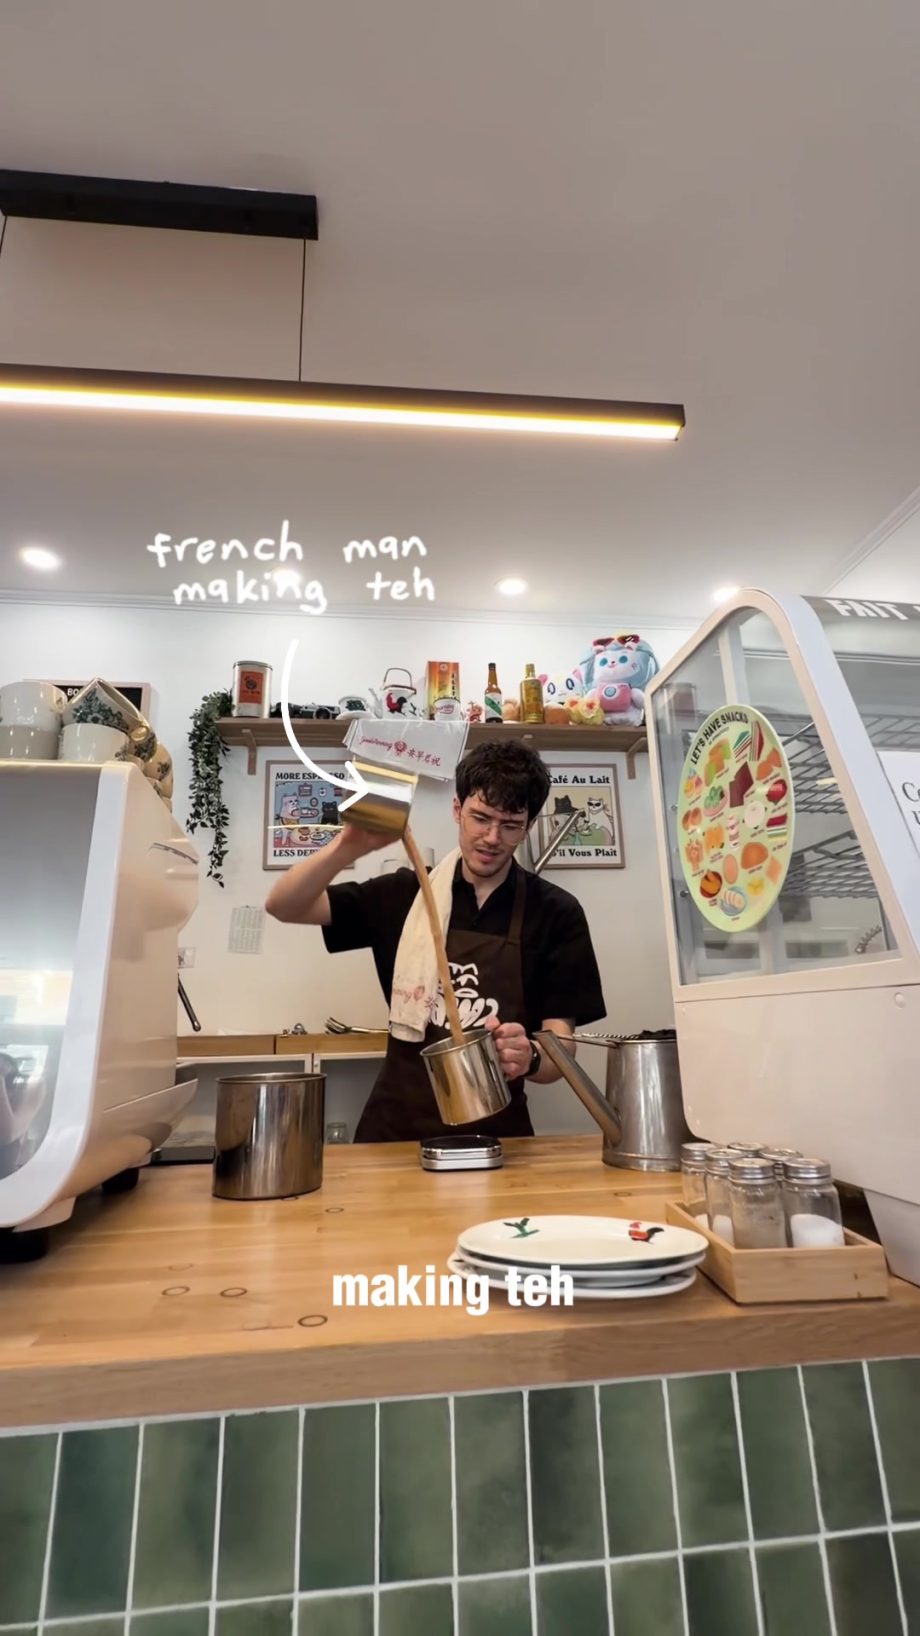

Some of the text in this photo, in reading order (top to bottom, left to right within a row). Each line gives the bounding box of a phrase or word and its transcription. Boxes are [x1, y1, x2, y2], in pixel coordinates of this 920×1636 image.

[823, 599, 909, 620] FAIT
[690, 737, 706, 765] LET'S
[702, 717, 722, 741] HAVE
[275, 772, 301, 780] MORE
[571, 775, 586, 784] Au
[589, 775, 611, 784] Lait
[273, 849, 296, 857] LESS
[568, 848, 592, 857] Vous
